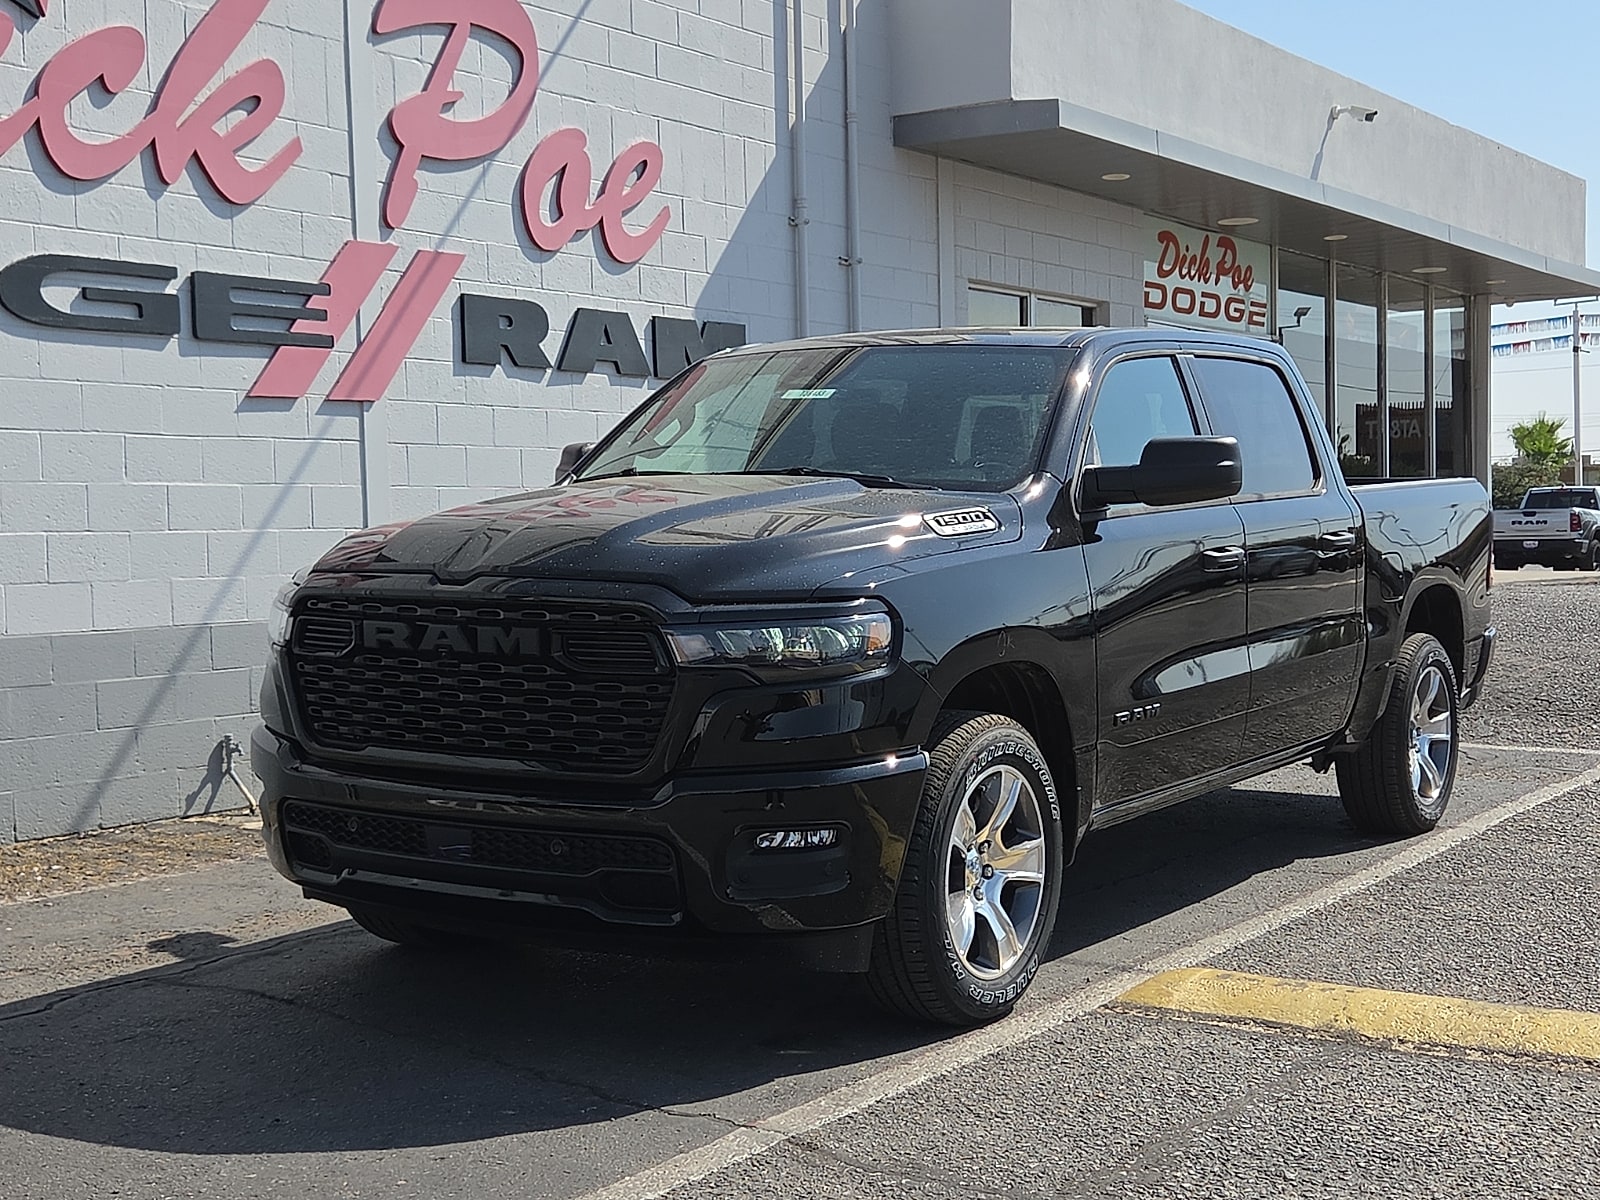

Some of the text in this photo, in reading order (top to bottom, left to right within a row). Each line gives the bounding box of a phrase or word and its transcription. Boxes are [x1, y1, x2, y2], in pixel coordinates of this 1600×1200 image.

[0, 0, 671, 264] ck Poe
[1156, 230, 1254, 292] Dick Poe
[1144, 280, 1267, 327] DODGE
[460, 293, 747, 381] RAM
[934, 511, 985, 527] 1500
[363, 619, 540, 656] RAM
[1112, 702, 1161, 727] RAM
[965, 741, 1060, 820] BRIDGESTONE
[968, 953, 1040, 1004] DUELER
